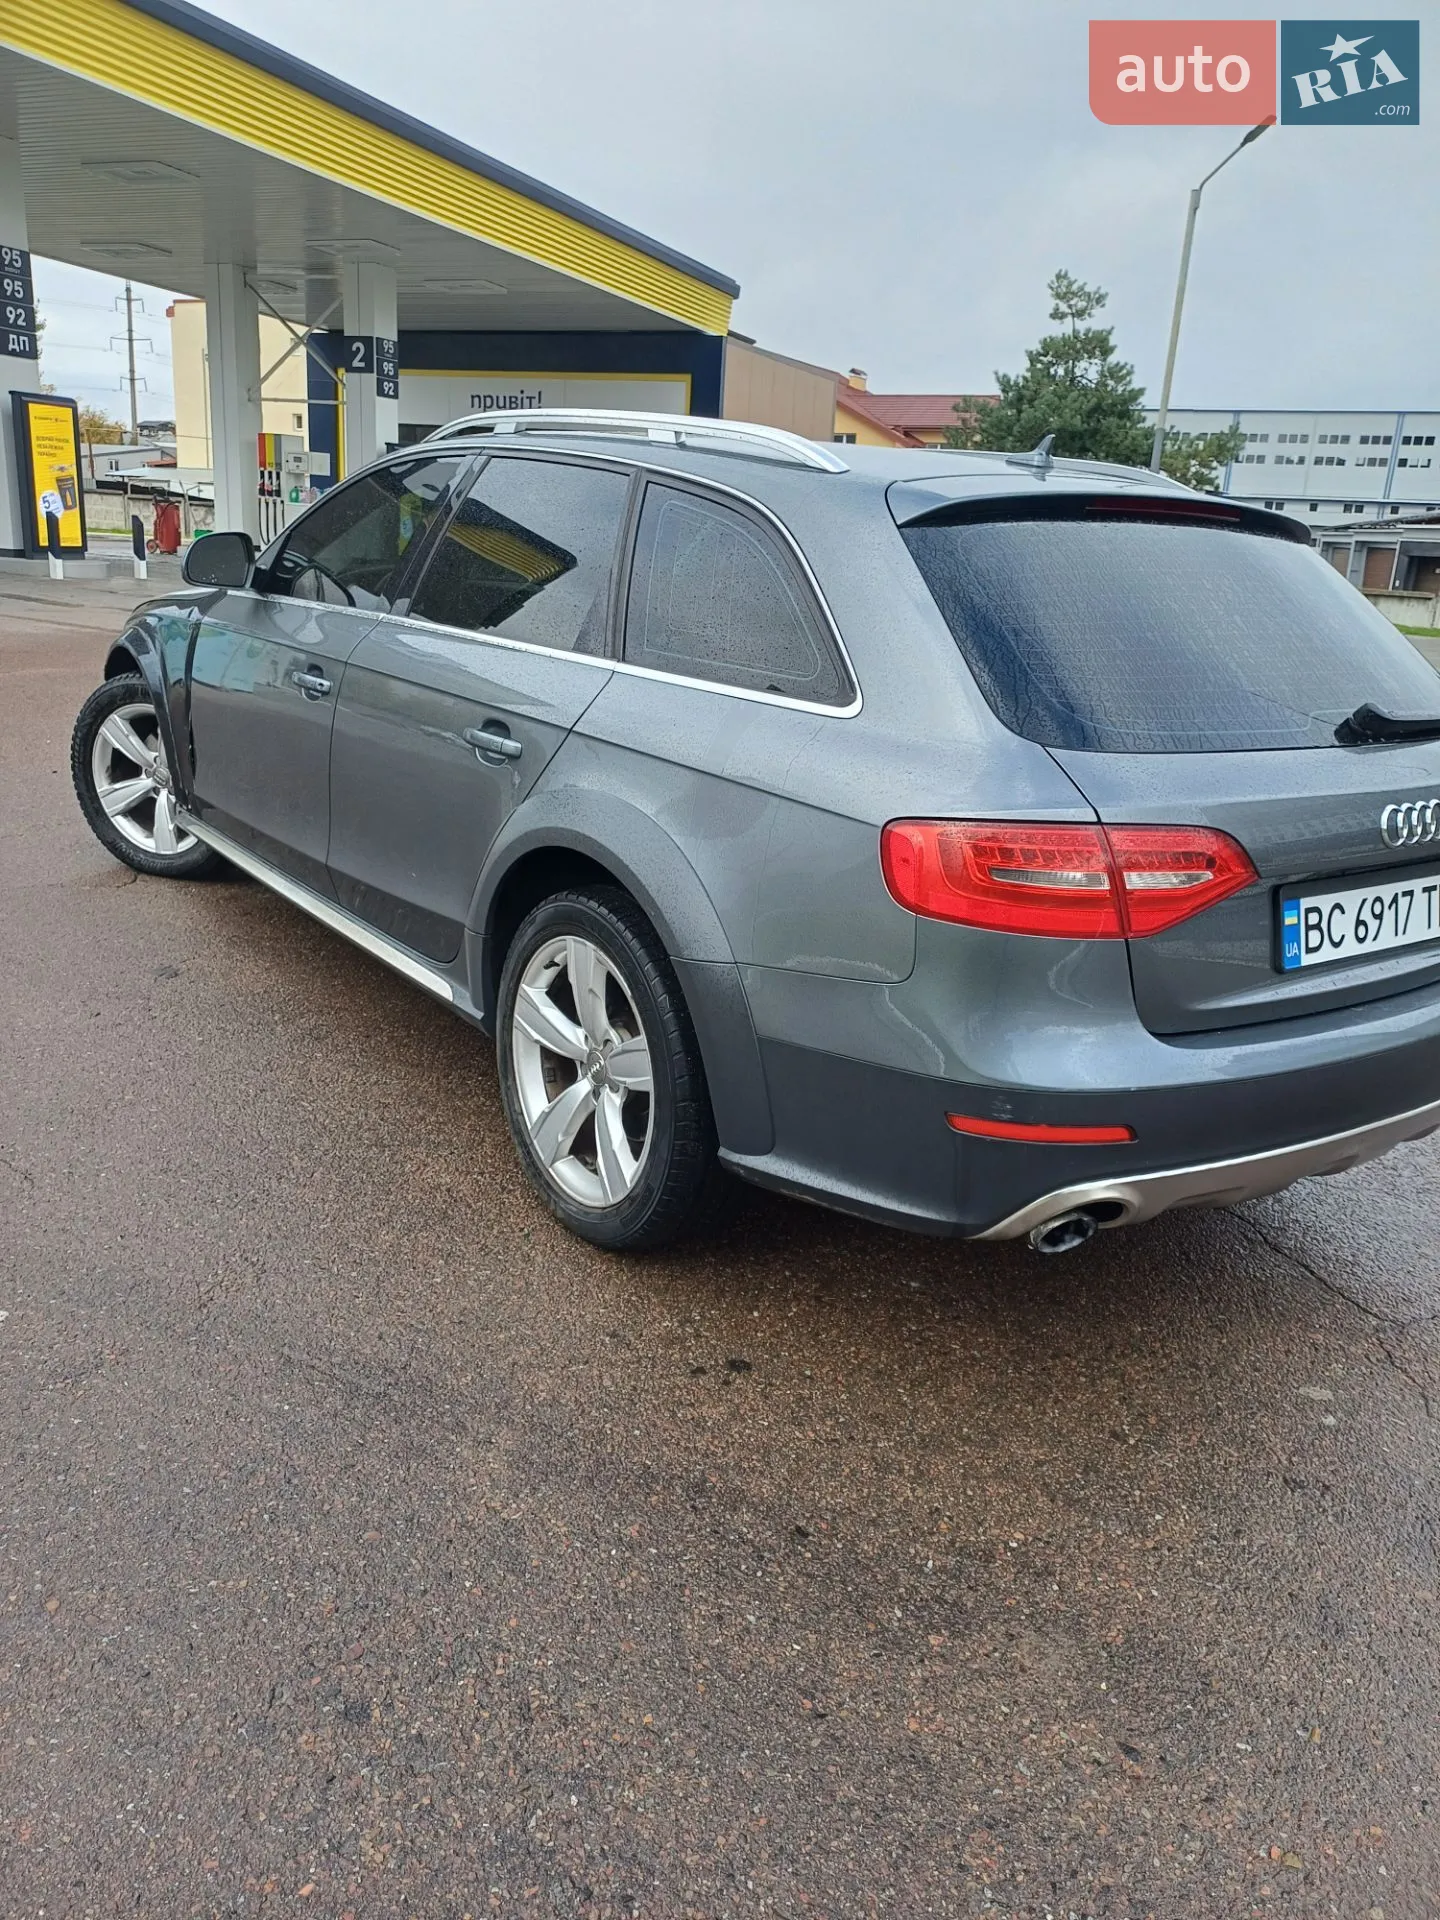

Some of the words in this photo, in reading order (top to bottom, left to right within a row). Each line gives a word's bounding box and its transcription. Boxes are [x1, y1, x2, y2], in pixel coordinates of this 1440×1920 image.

[1, 247, 22, 268] 95
[3, 278, 24, 299] 95
[6, 306, 26, 326] 92
[8, 333, 30, 352] ДП
[382, 339, 394, 354] 95
[351, 341, 366, 368] 2
[382, 361, 394, 376] 95
[383, 381, 395, 395] 92
[470, 389, 542, 412] привіт!
[42, 495, 51, 510] 5
[1304, 902, 1346, 954] BC
[1354, 889, 1415, 944] 6917
[1421, 884, 1440, 929] T
[1285, 941, 1299, 958] UA
